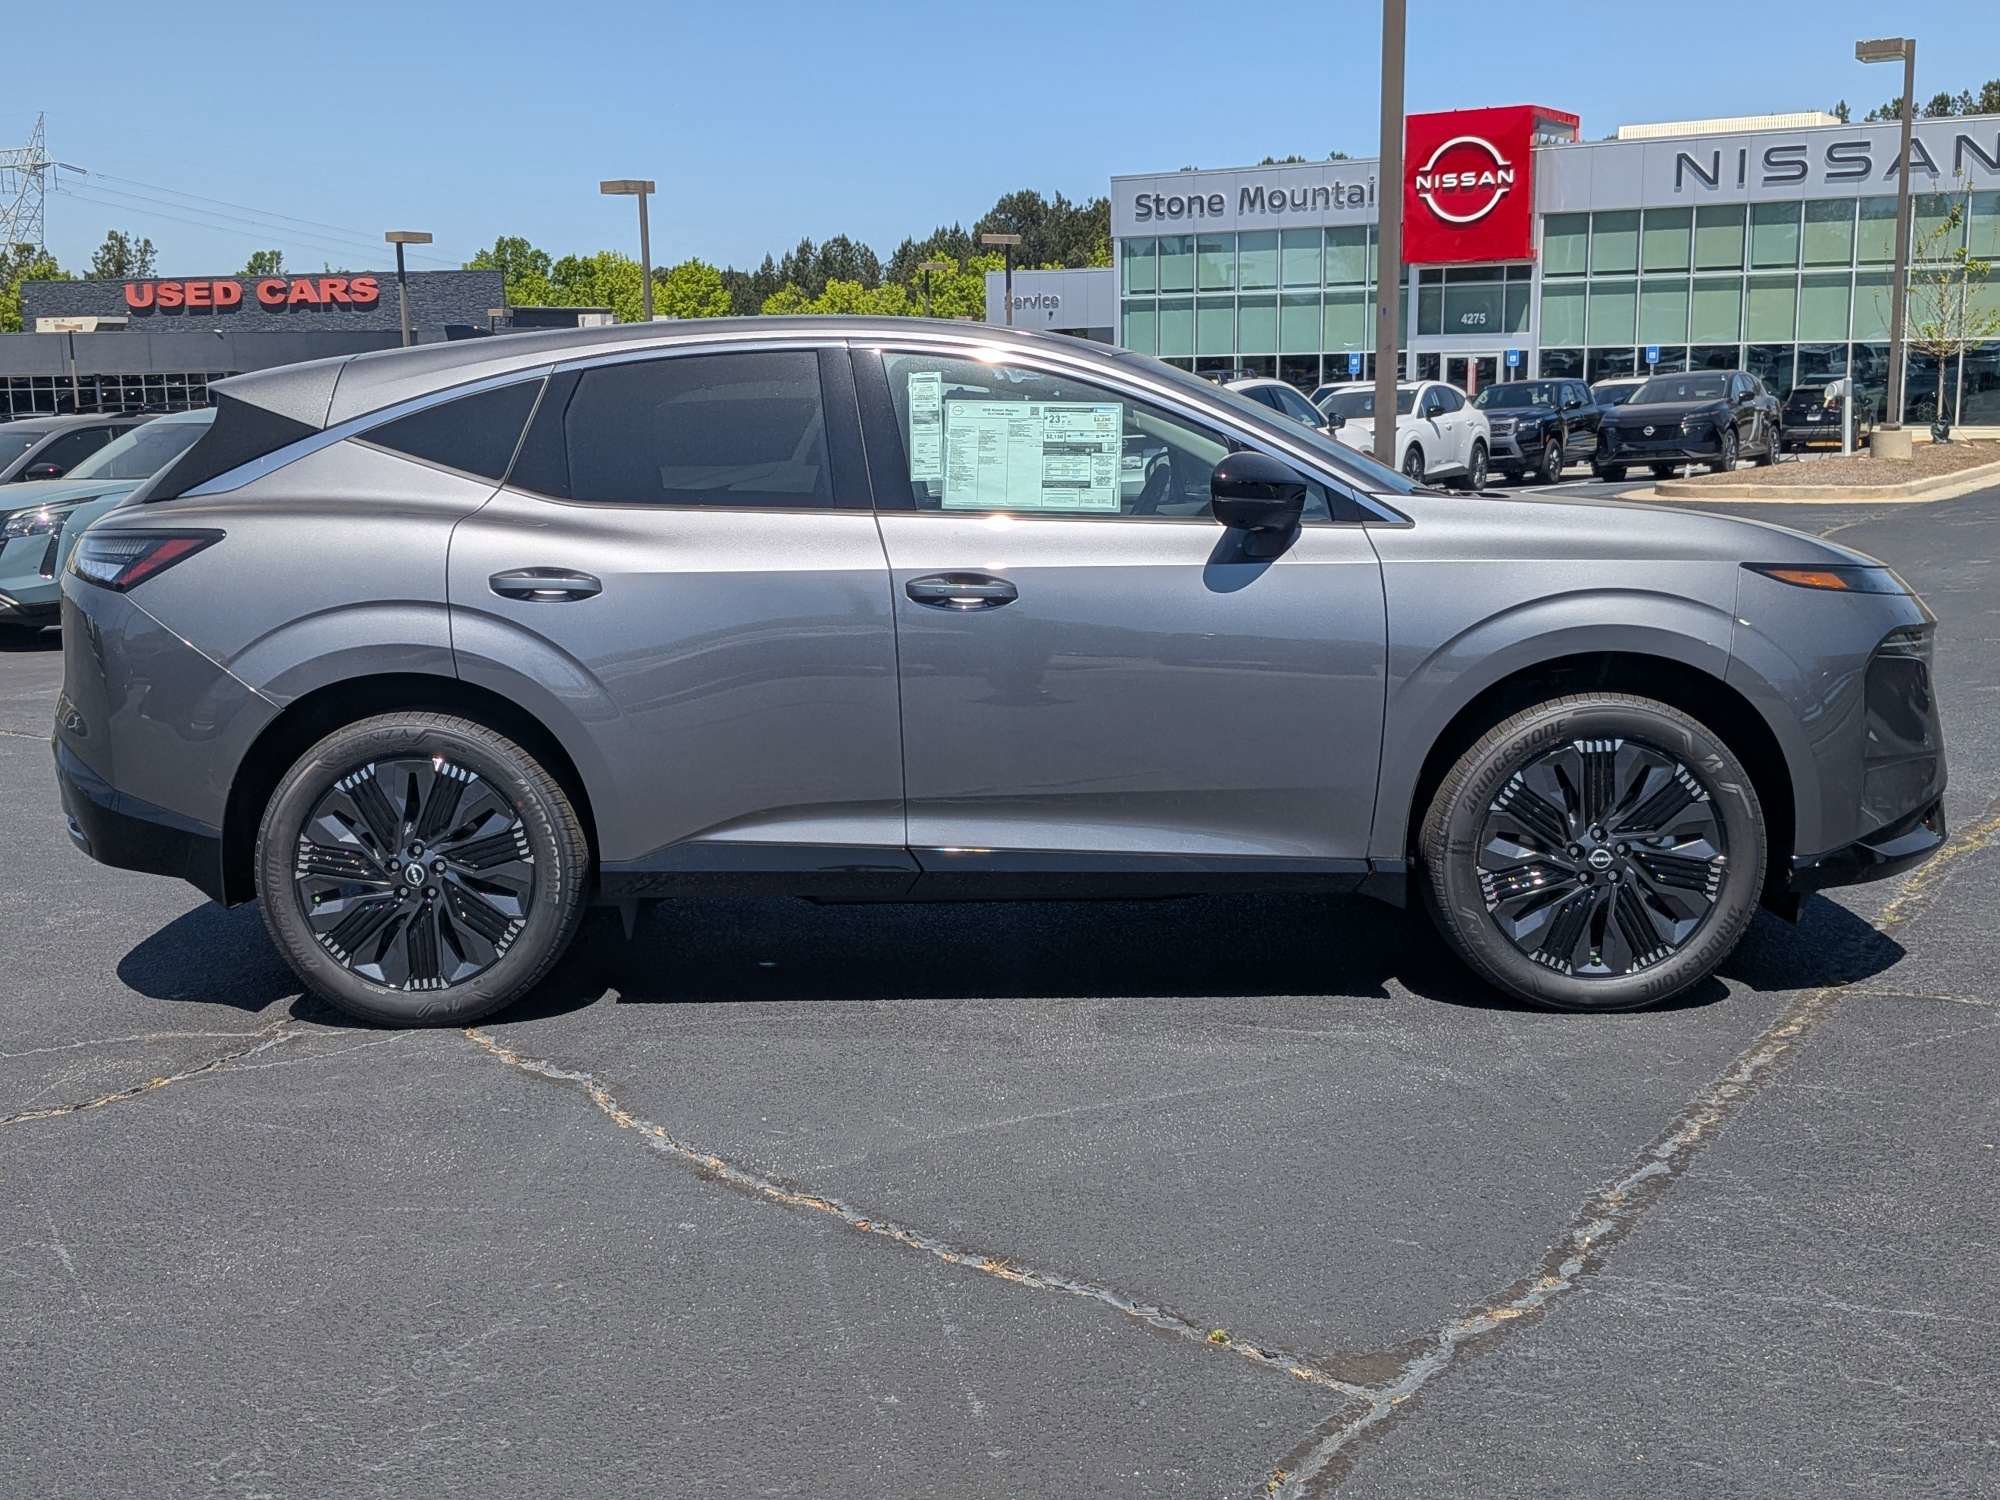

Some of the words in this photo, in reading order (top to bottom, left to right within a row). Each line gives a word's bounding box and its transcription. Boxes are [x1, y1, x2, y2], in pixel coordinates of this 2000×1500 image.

[1675, 132, 2000, 188] NISSAN
[1416, 169, 1515, 189] NISSAN
[1135, 193, 1225, 219] Stone
[1239, 176, 1376, 213] Mountai
[123, 280, 243, 308] USED
[256, 277, 380, 304] CARS
[1005, 293, 1060, 310] ervice
[1461, 313, 1486, 324] 4275
[1049, 415, 1061, 424] 23
[1462, 718, 1568, 816] BRIDGESTONE
[1640, 904, 1743, 996] BRIDGESTONE
